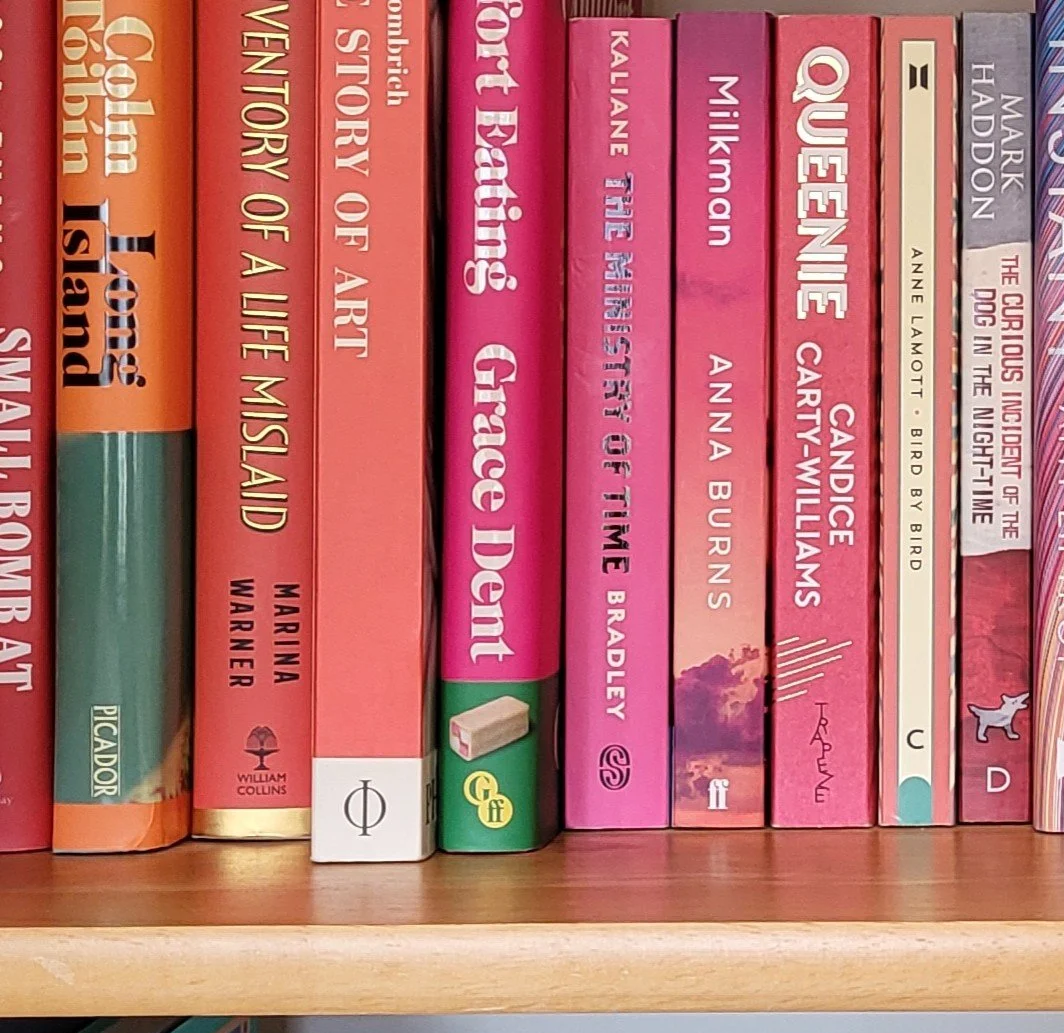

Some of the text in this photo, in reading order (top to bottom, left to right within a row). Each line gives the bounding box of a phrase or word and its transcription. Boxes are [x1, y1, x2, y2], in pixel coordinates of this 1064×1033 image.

[104, 16, 155, 178] Colm
[611, 30, 629, 157] KALIANE
[971, 63, 994, 221] HADDON
[1000, 93, 1024, 193] MARK
[334, 28, 371, 358] STORY OF ART
[792, 45, 850, 320] QUEENIE
[62, 199, 109, 388] Island
[104, 230, 156, 388] Long
[707, 75, 739, 610] Milkman ANNA BURNS
[464, 106, 522, 663] Eating Grace Dent
[909, 247, 923, 572] ANNE LAMOTT BIRD BY BIRD
[795, 342, 822, 608] CARTY-WILLIAMS
[828, 402, 855, 546] CANDICE
[230, 579, 255, 687] WARNER
[274, 583, 300, 684] MARINA
[606, 590, 625, 720] BRADLEY
[93, 705, 119, 798] PICADOR
[237, 773, 287, 782] WILLIAM
[237, 785, 287, 795] COLLINS
